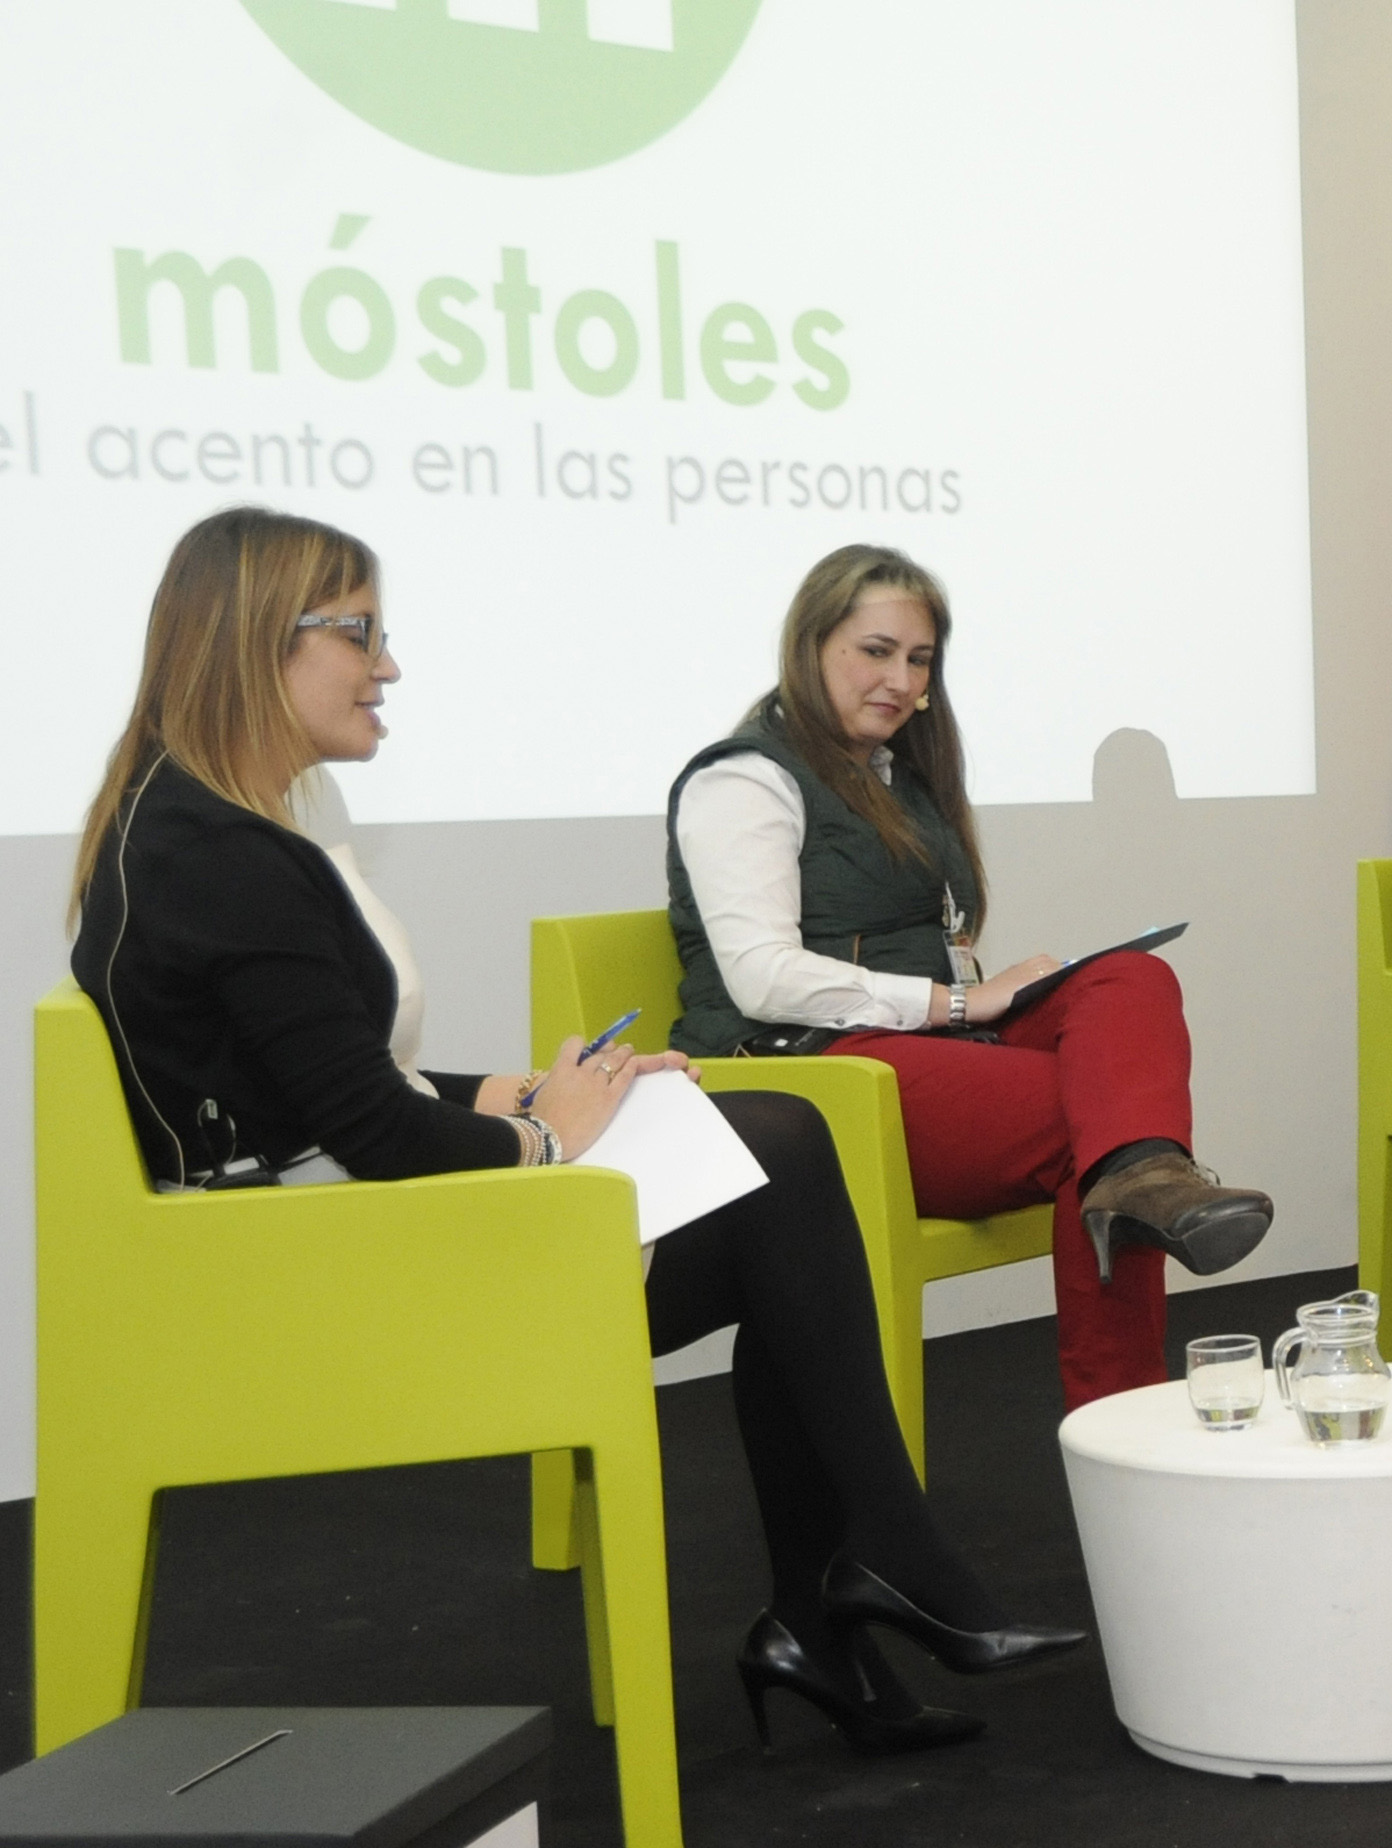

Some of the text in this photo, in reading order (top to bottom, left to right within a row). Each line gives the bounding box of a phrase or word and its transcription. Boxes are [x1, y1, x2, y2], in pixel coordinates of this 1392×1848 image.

[113, 212, 852, 412] móstoles
[86, 421, 375, 491] acento
[412, 441, 500, 500] en
[534, 421, 634, 502] las
[666, 454, 963, 526] personas
